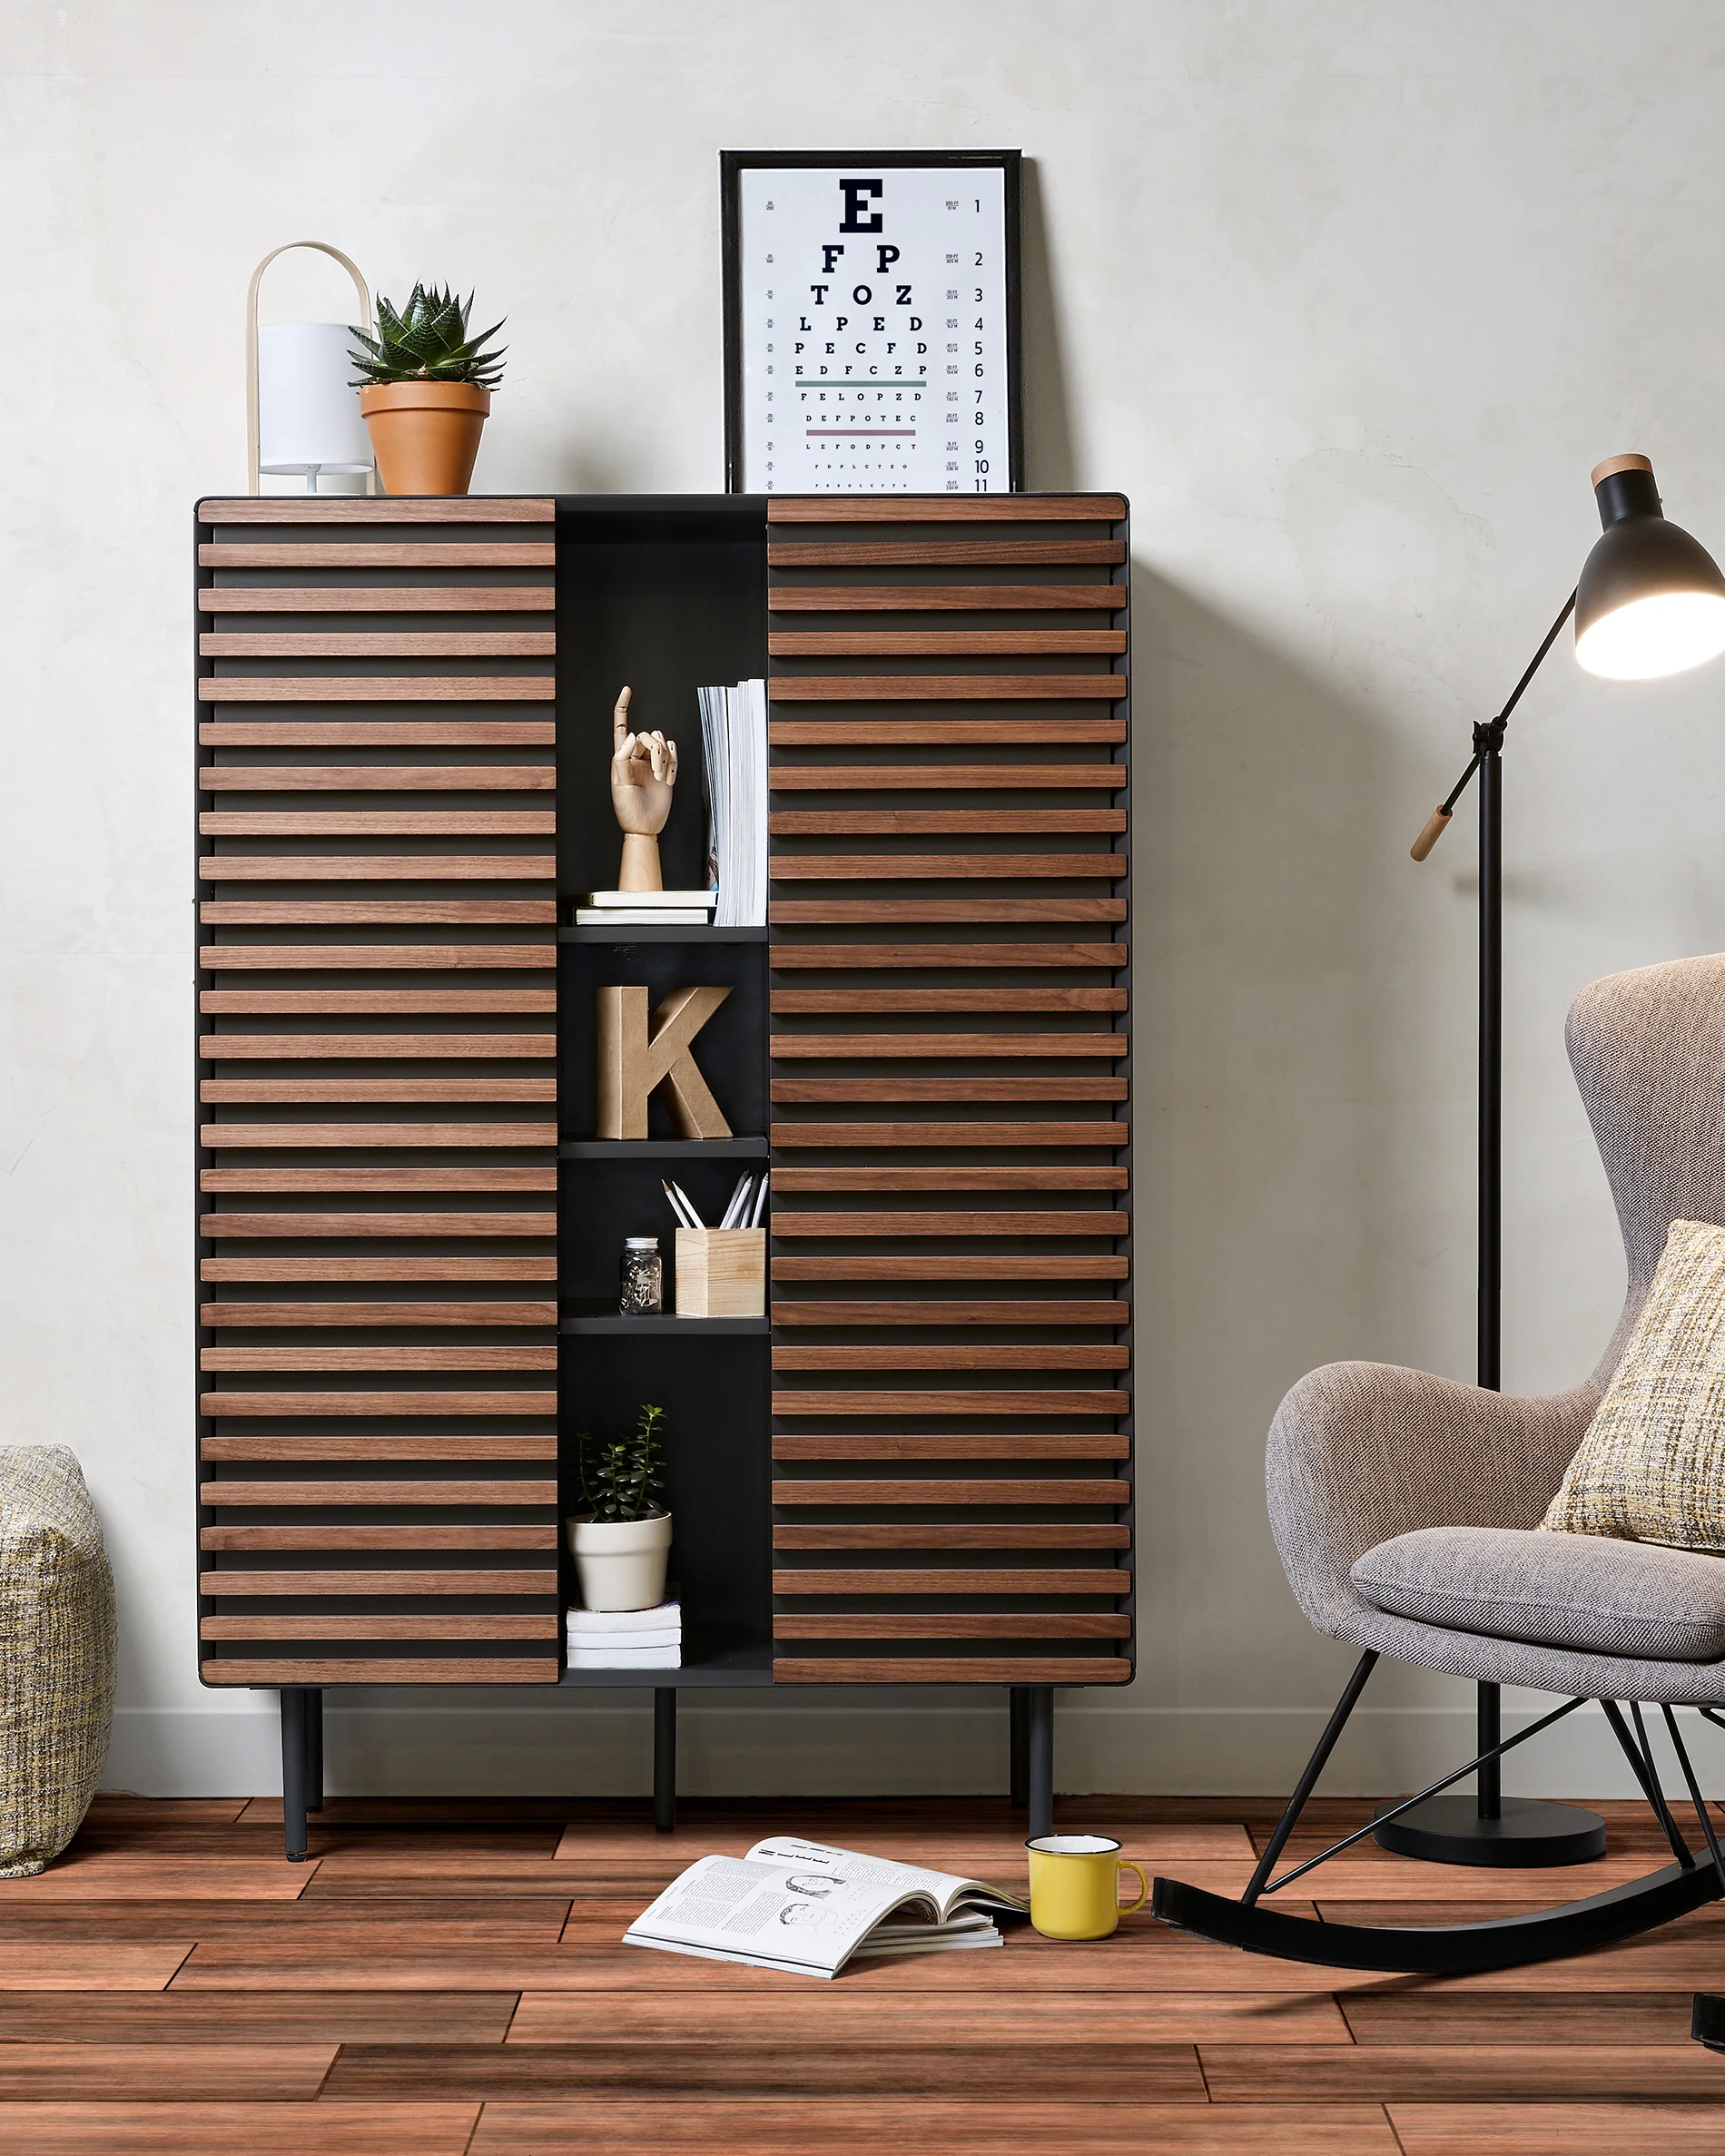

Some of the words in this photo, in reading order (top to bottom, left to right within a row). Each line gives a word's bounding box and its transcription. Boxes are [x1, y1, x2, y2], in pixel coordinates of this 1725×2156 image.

[840, 179, 882, 233] E
[823, 245, 844, 273] F
[877, 245, 900, 273] P
[974, 252, 982, 266] 2
[811, 285, 829, 305] T
[853, 285, 872, 305] O
[896, 285, 912, 305] Z
[974, 288, 983, 302] 3
[800, 317, 811, 330] L
[836, 317, 848, 330] P
[873, 317, 884, 330] E
[910, 317, 922, 330] D
[974, 318, 983, 330] 4
[795, 343, 804, 354] P
[825, 343, 834, 354] E
[856, 343, 865, 354] C
[887, 343, 896, 354] F
[917, 343, 927, 354] D
[974, 341, 983, 355] 5
[795, 365, 803, 375] E
[820, 365, 828, 375] D
[844, 365, 853, 375] F
[869, 365, 878, 375] C
[894, 365, 902, 375] Z
[919, 365, 927, 375] P
[974, 363, 983, 377] 6
[801, 393, 807, 401] F
[820, 393, 826, 401] E
[838, 393, 844, 401] L
[857, 393, 864, 401] O
[877, 393, 883, 401] P
[895, 393, 902, 401] Z
[914, 393, 922, 401] D
[974, 390, 983, 403] 7
[974, 411, 983, 426] 8
[974, 439, 983, 454] 9
[974, 460, 989, 474] 10
[975, 479, 987, 492] 11
[597, 986, 734, 1140] K
